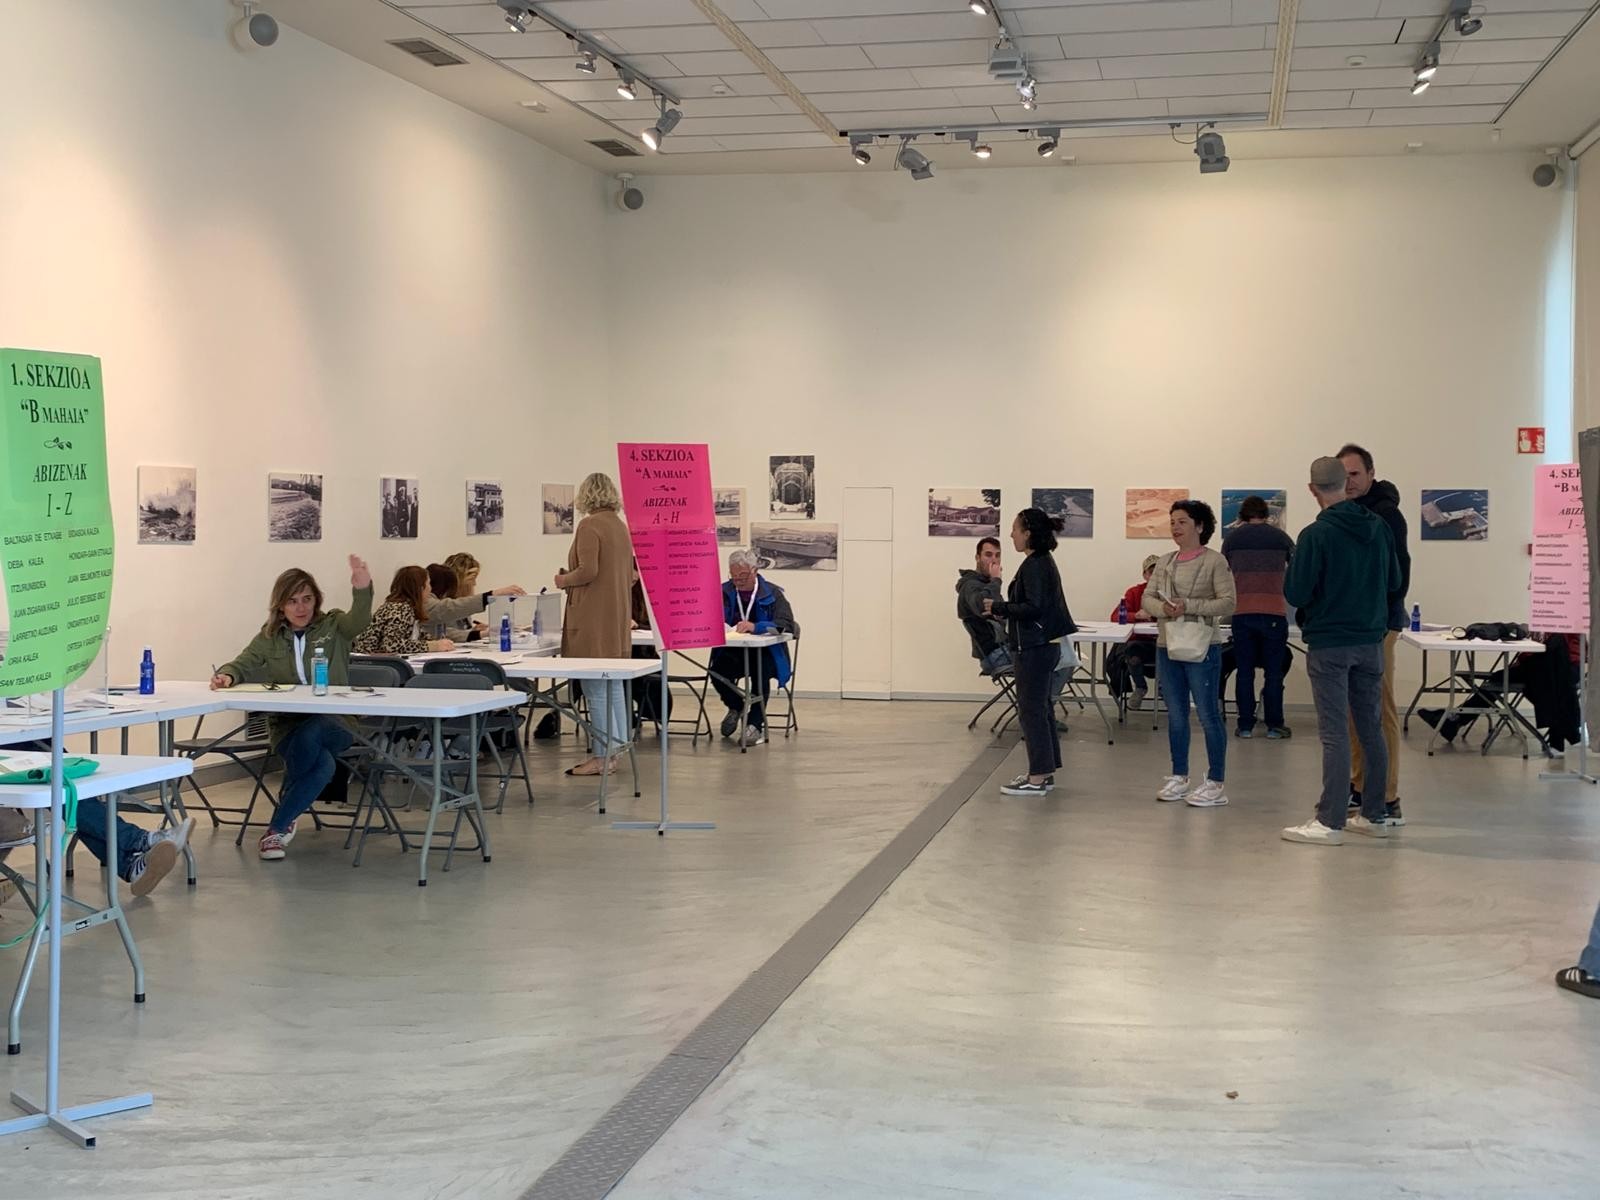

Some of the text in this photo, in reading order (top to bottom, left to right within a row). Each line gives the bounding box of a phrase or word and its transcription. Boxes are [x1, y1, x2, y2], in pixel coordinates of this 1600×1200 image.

[11, 363, 91, 390] 1. SEKZIOA
[630, 449, 694, 462] 4. SEKZIOA
[33, 463, 88, 483] ABIZENAK
[1549, 469, 1559, 479] 4.
[64, 492, 73, 516] Z
[643, 497, 688, 508] ABIZENAK
[653, 512, 660, 524] A
[670, 511, 680, 524] H
[4, 534, 33, 545] BALTASAR
[35, 533, 42, 542] DE
[8, 556, 44, 570] DEBA KALEA
[67, 575, 79, 584] JUAN
[13, 608, 26, 618] JUAN
[47, 601, 60, 611] KALEA
[8, 652, 39, 666] ORIA KALEA
[0, 671, 52, 688] SAN TELMO KALEA
